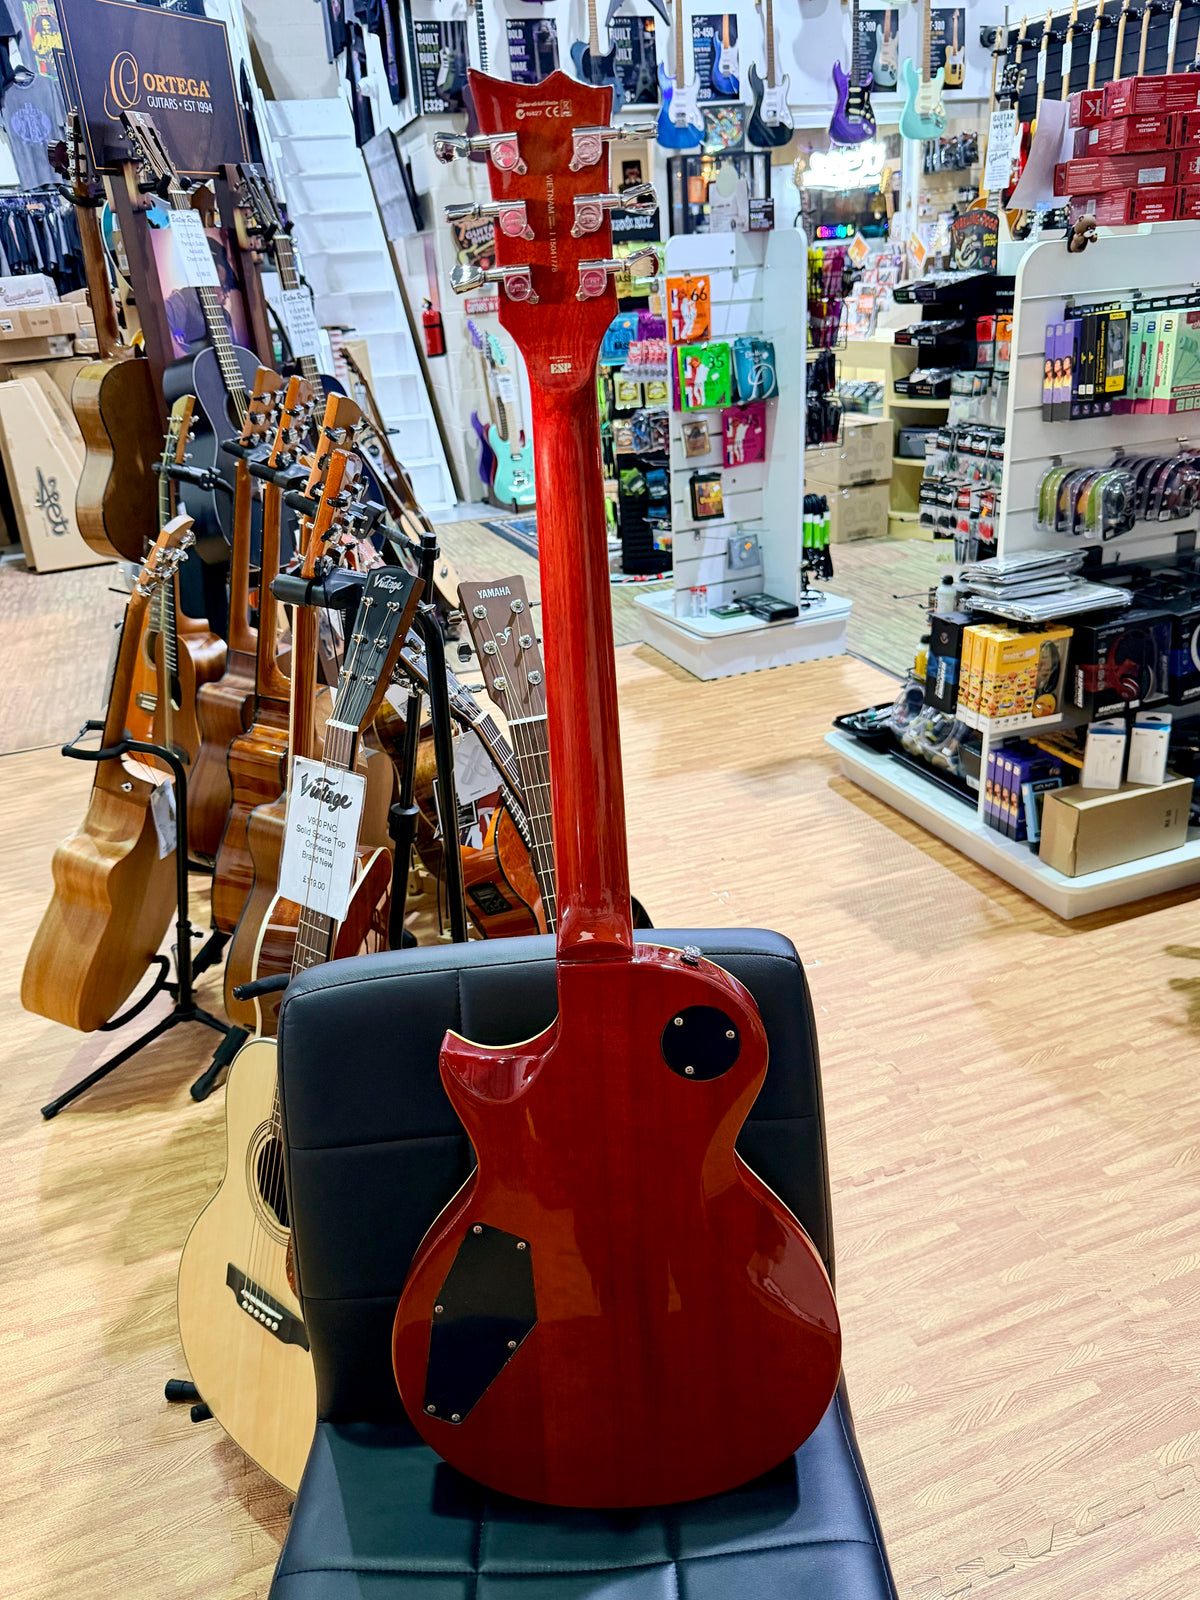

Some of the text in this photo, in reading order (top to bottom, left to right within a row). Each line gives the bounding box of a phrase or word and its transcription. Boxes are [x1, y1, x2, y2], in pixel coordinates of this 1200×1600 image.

[859, 21, 876, 32] S-300
[417, 33, 439, 45] BUILT
[419, 53, 439, 64] BUILT
[616, 48, 633, 60] UILT
[143, 72, 211, 99] ORTEGA
[147, 95, 214, 114] GUITARS EST 1994
[546, 173, 555, 214] VIETNAM
[466, 224, 495, 240] GUITA
[690, 287, 708, 302] 66
[707, 356, 724, 369] 35
[372, 574, 404, 594] Vintage
[477, 586, 511, 599] YAMAHA
[300, 772, 353, 812] Vintage
[323, 821, 338, 833] PNC
[296, 824, 346, 850] Solid Spruce Top
[302, 850, 334, 869] Brad New
